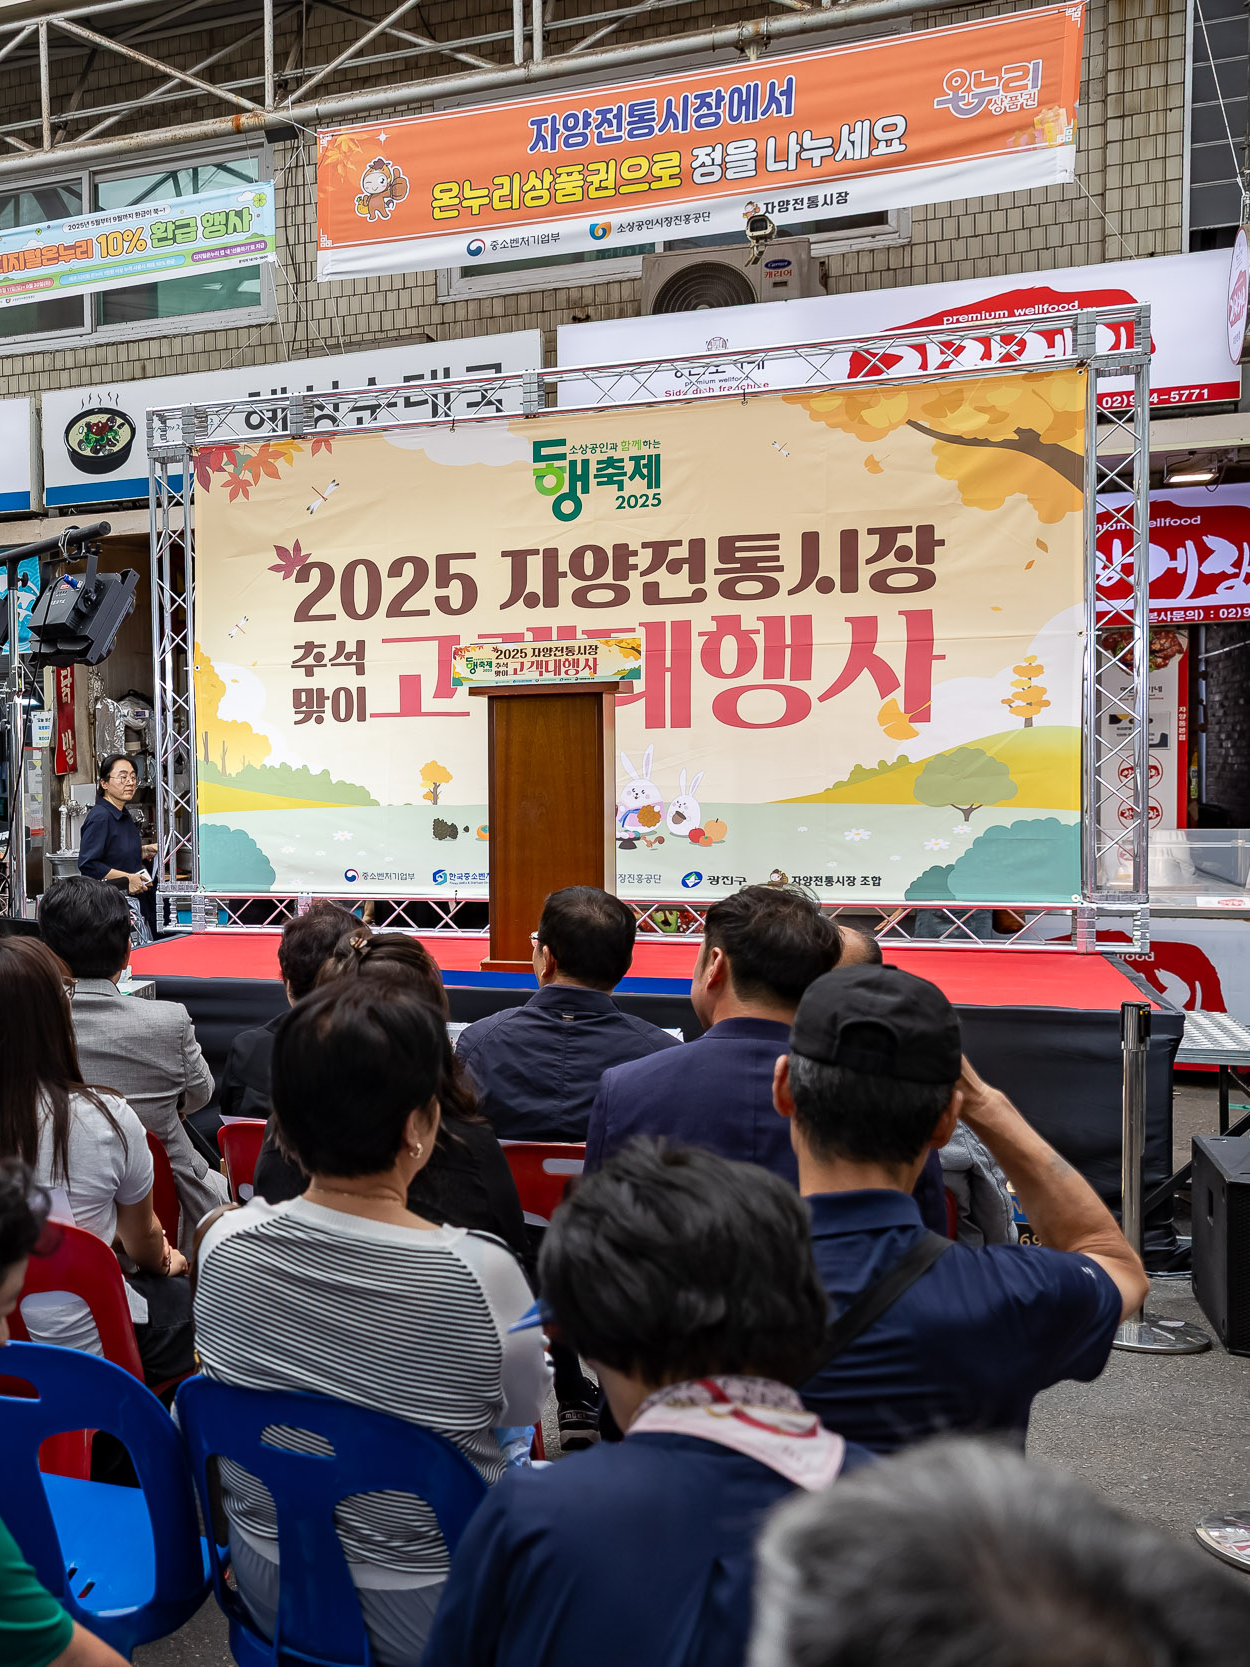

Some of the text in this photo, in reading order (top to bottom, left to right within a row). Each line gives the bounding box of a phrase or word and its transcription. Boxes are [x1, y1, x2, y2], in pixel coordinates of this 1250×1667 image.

[989, 89, 1038, 114] 상품권
[527, 75, 796, 153] 자양전통시장에서
[430, 114, 907, 220] 온누리상품권으로 정을 나누세요
[763, 190, 850, 216] 자양전통시장
[96, 227, 147, 258] 10%
[150, 217, 198, 248] 환급
[200, 207, 252, 239] 행사
[617, 211, 711, 234] 소상공인시장진흥공단
[490, 231, 560, 251] 중소벤처기업부
[764, 268, 792, 278] 캐리어
[942, 301, 1078, 325] premium wellfood
[1102, 388, 1209, 408] 02)94-5771
[569, 439, 661, 455] 소상공인과 함께하는
[615, 493, 662, 510] 2025
[1149, 515, 1201, 528] ellfood
[293, 523, 944, 623] 2025 자양전통시장
[292, 640, 366, 677] 추석
[495, 645, 599, 660] 2025 자양전통시장
[369, 608, 946, 730] 고대행사
[509, 657, 599, 677] 고객대행사
[292, 684, 367, 726] 맞이
[706, 875, 747, 886] 광진구
[791, 875, 881, 887] 자양전통시장 조합
